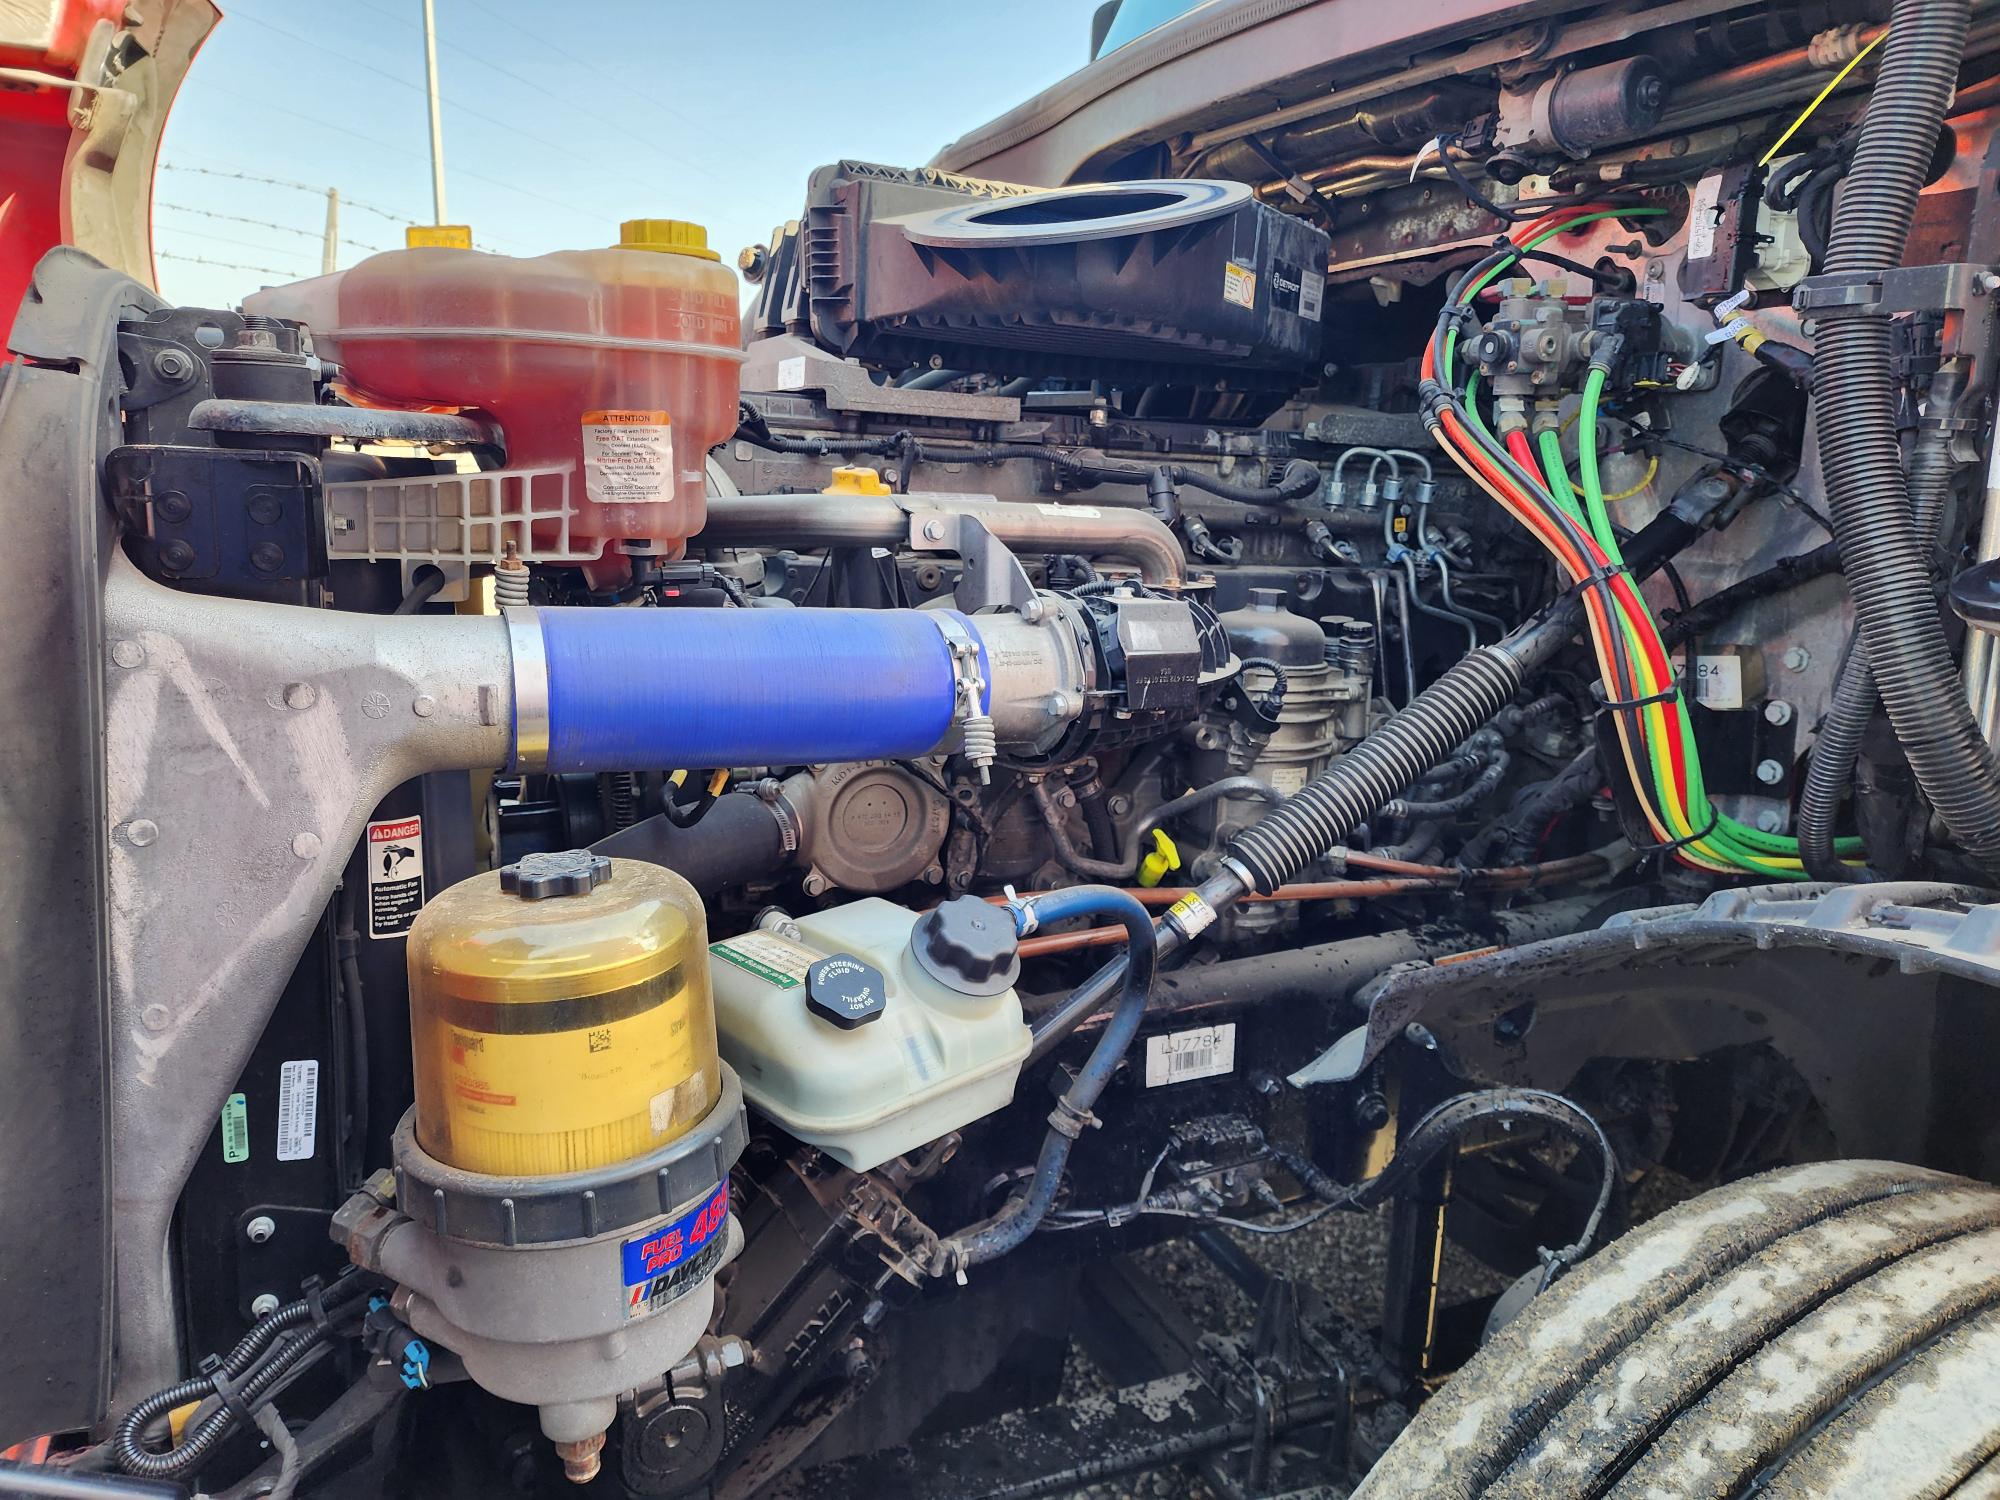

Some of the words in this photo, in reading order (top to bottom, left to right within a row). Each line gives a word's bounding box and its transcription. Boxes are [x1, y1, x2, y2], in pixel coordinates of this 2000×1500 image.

[1279, 278, 1300, 293] DETROIT
[603, 414, 651, 422] ATTENTION
[384, 823, 419, 839] DANGER
[374, 884, 407, 893] Automatic
[374, 894, 390, 902] Keep
[390, 892, 407, 900] hands
[817, 965, 830, 986] POWER
[829, 960, 865, 973] STEERING
[827, 966, 850, 979] FLUID
[841, 987, 870, 1003] OVERFILL
[864, 997, 875, 1007] DO
[849, 1002, 865, 1010] NOT
[640, 1227, 685, 1260] FUEL
[646, 1243, 684, 1274] PRO
